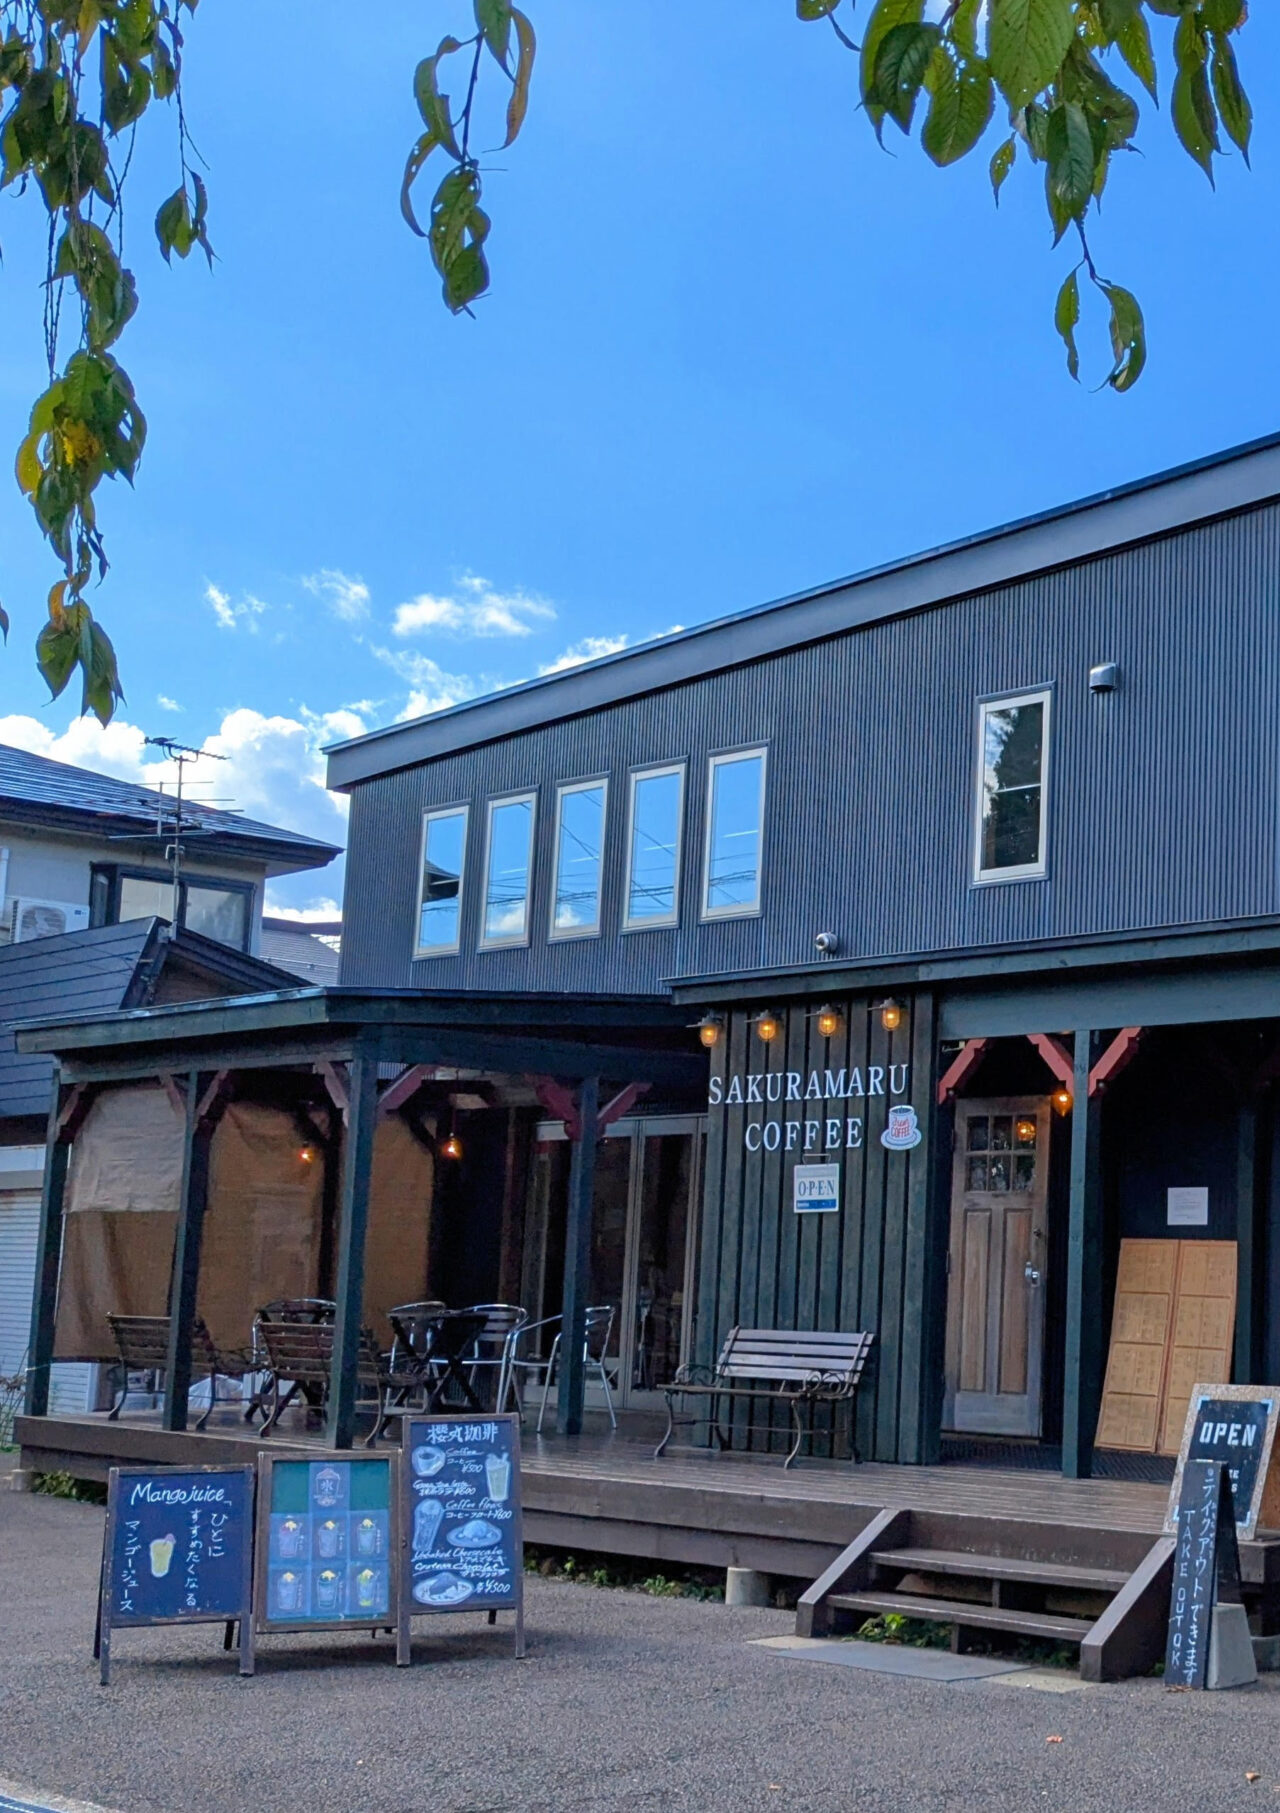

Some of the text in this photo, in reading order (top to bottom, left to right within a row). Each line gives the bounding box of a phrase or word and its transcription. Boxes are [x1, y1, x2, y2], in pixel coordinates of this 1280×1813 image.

[708, 1064, 908, 1104] SAKURAMARU
[745, 1118, 862, 1151] COFFEE
[1199, 1422, 1257, 1446] OPEN
[130, 1481, 224, 1505] Mango juice
[120, 1520, 141, 1611] マンゴージュース
[1171, 1510, 1196, 1668] TAKE OUT OK
